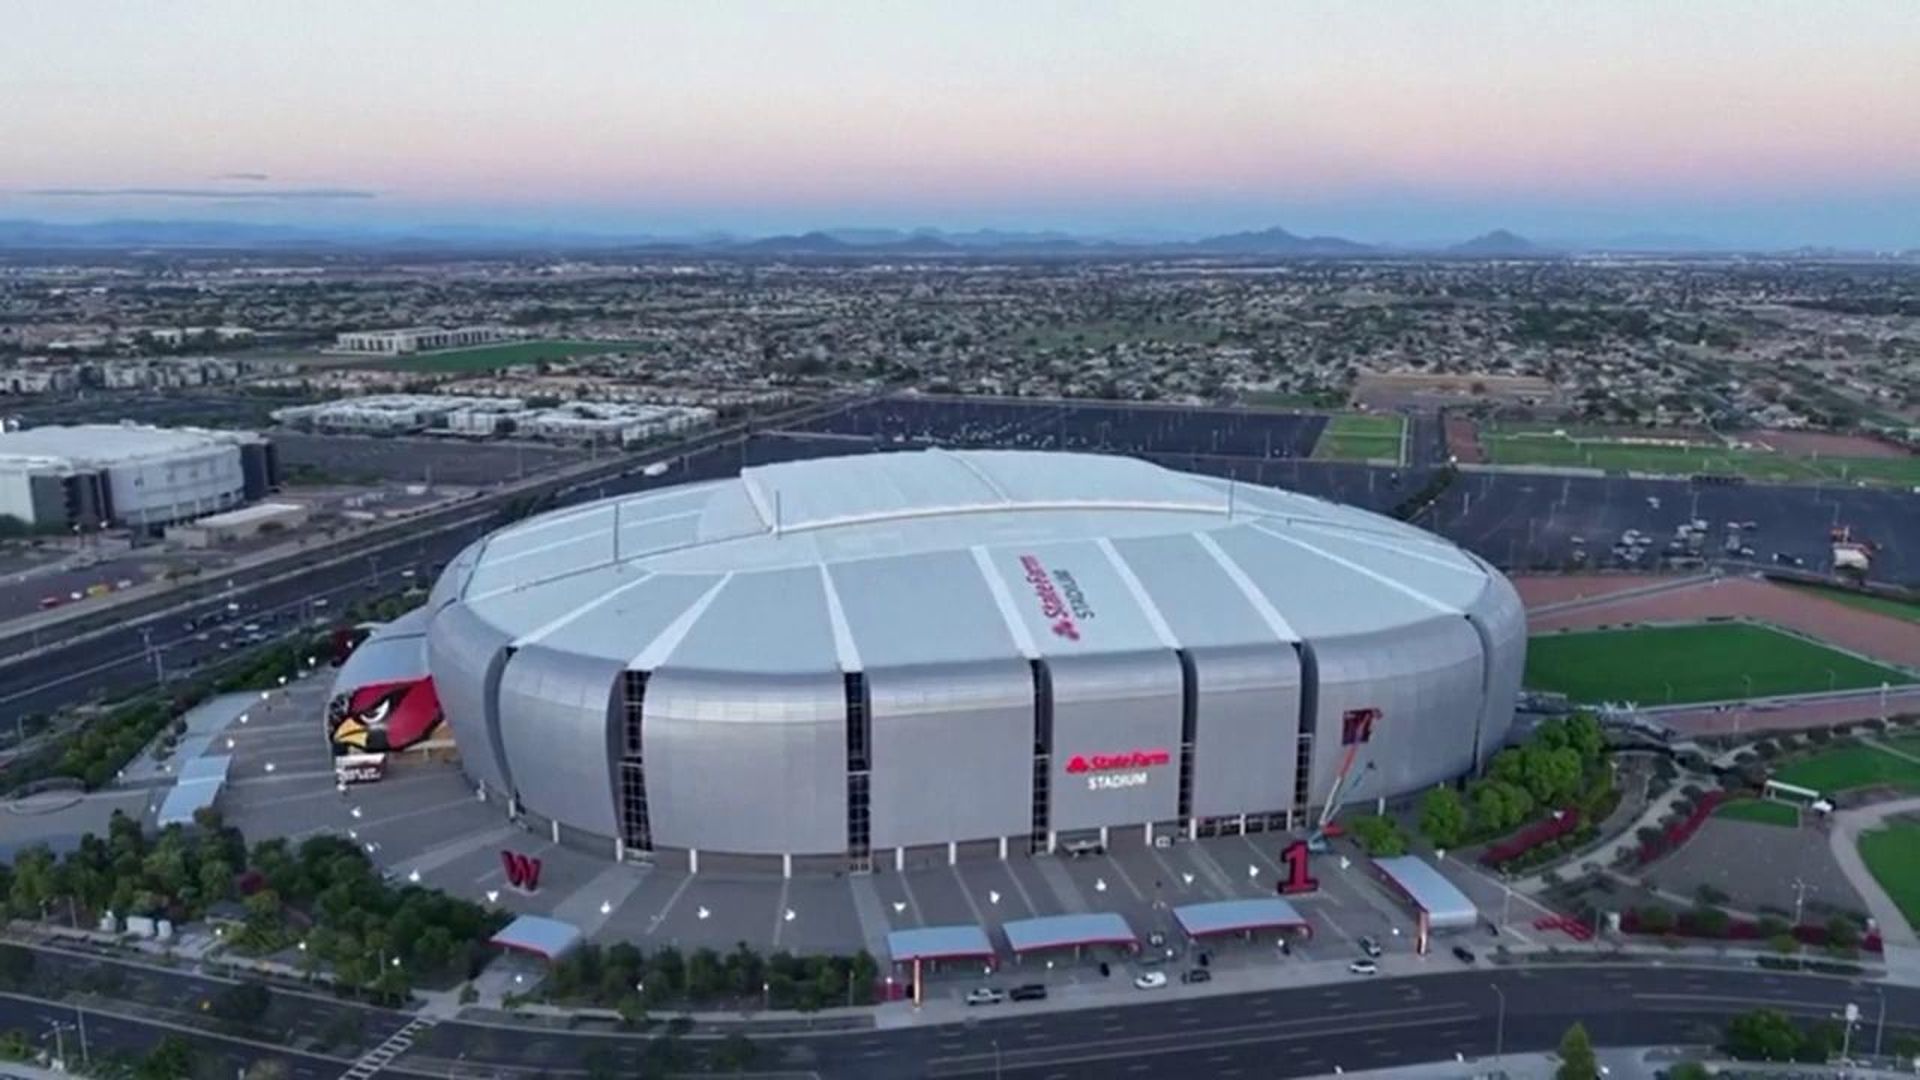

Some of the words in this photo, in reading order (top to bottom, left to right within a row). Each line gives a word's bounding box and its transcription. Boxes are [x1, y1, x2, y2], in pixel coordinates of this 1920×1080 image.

[1087, 772, 1147, 790] STADIUM
[502, 850, 541, 892] W
[1276, 839, 1320, 895] 1
